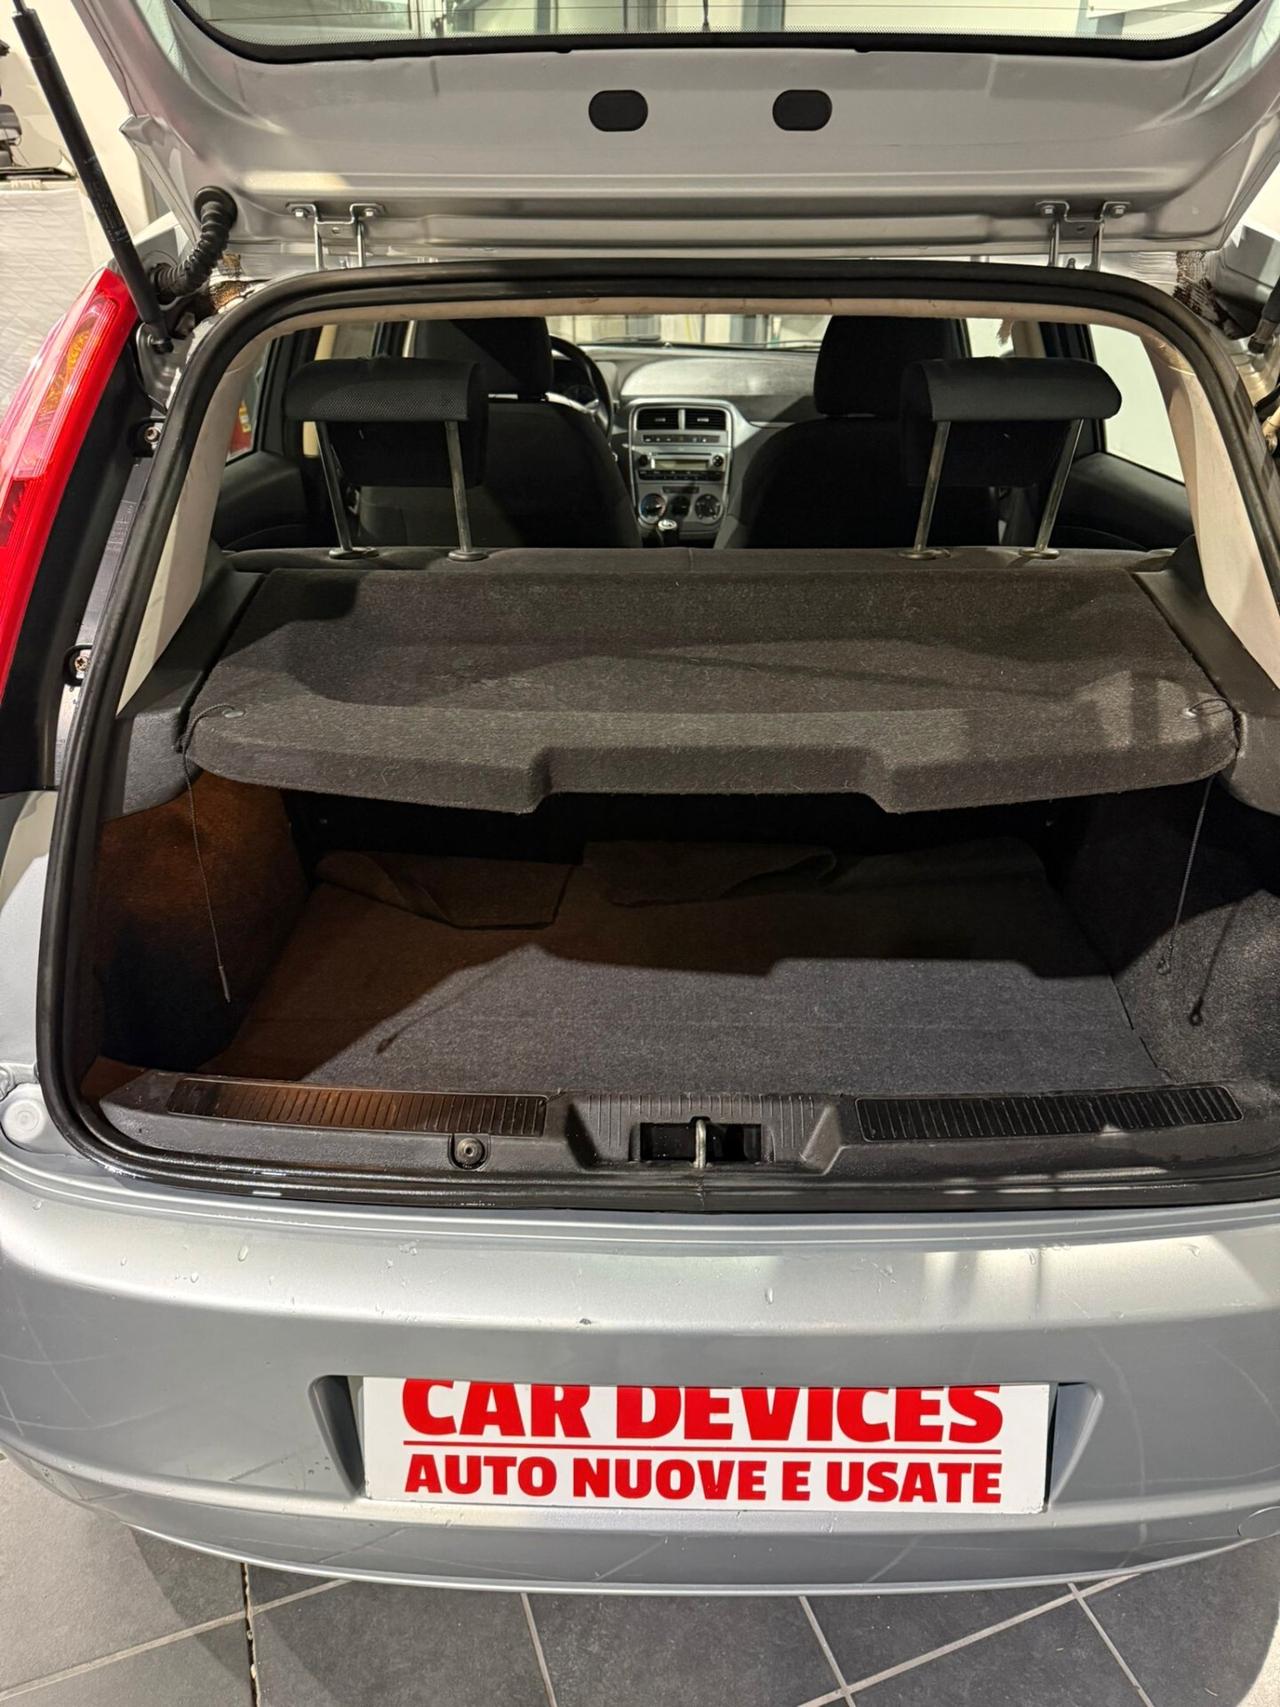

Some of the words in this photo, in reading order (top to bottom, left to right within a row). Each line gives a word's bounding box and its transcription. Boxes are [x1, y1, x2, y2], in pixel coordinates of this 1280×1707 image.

[401, 1379, 591, 1438] CAR
[616, 1385, 1004, 1444] DEVICES
[404, 1454, 558, 1497] AUTO
[572, 1458, 768, 1501] NUOVE
[781, 1461, 812, 1502] E
[826, 1461, 1003, 1504] USATE
